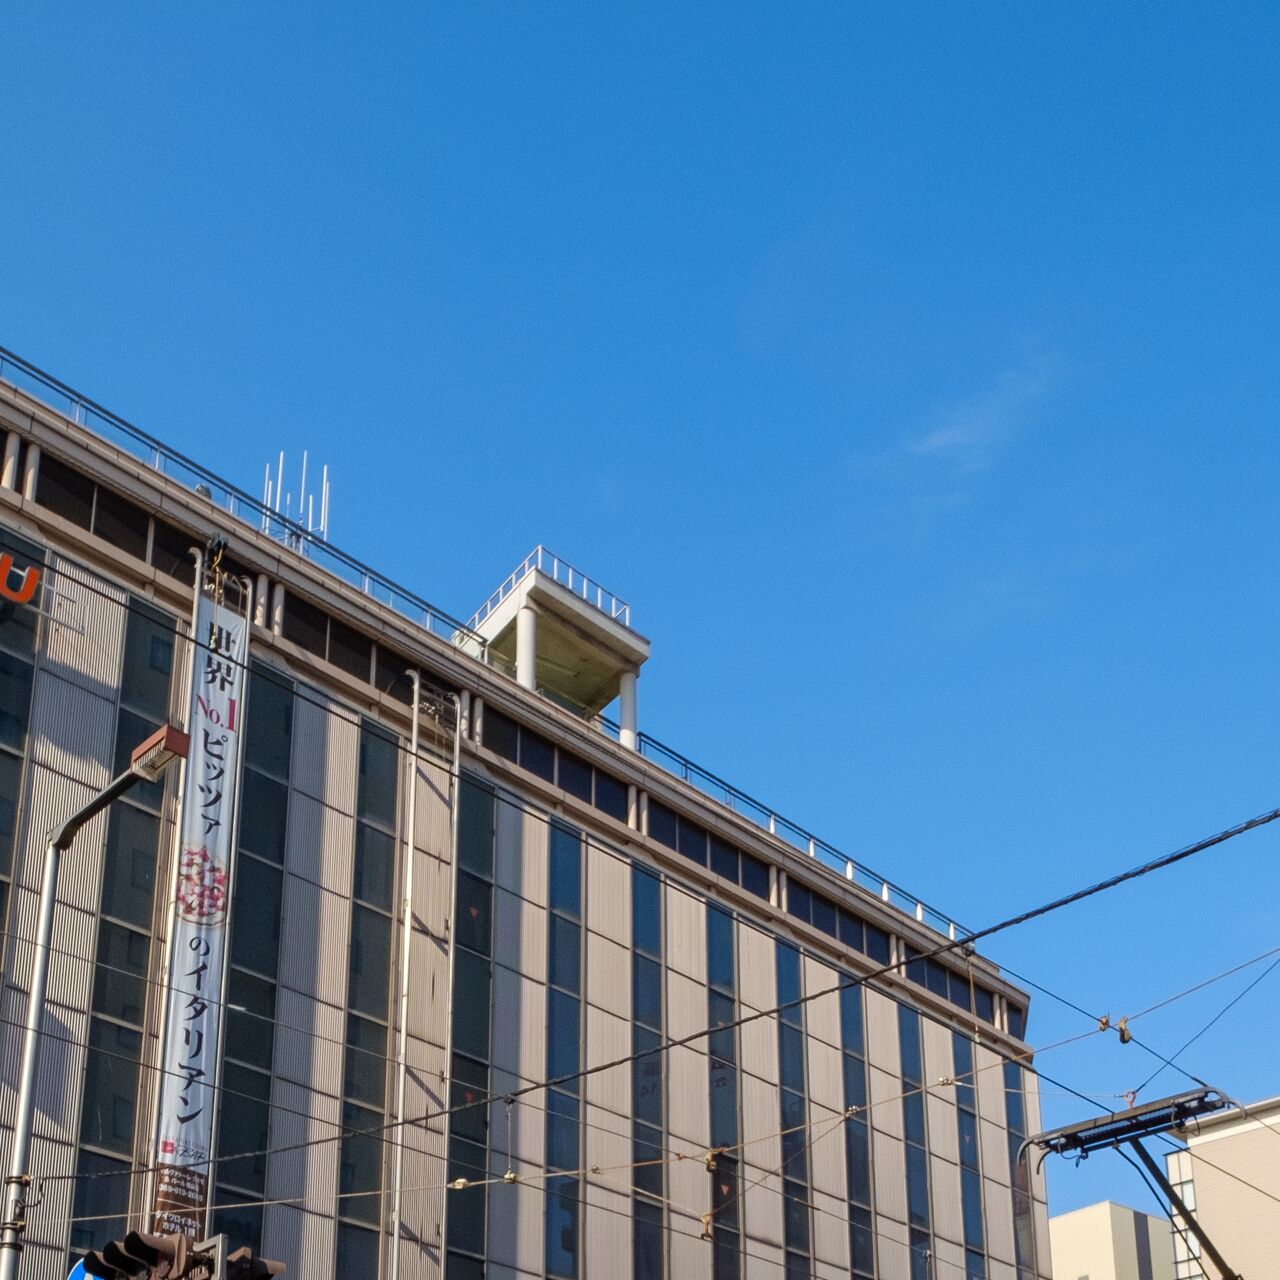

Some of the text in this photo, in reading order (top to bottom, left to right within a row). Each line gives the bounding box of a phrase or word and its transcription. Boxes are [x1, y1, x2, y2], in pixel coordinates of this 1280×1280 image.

[195, 694, 238, 732] No.1
[176, 936, 211, 1125] のイタリアン
